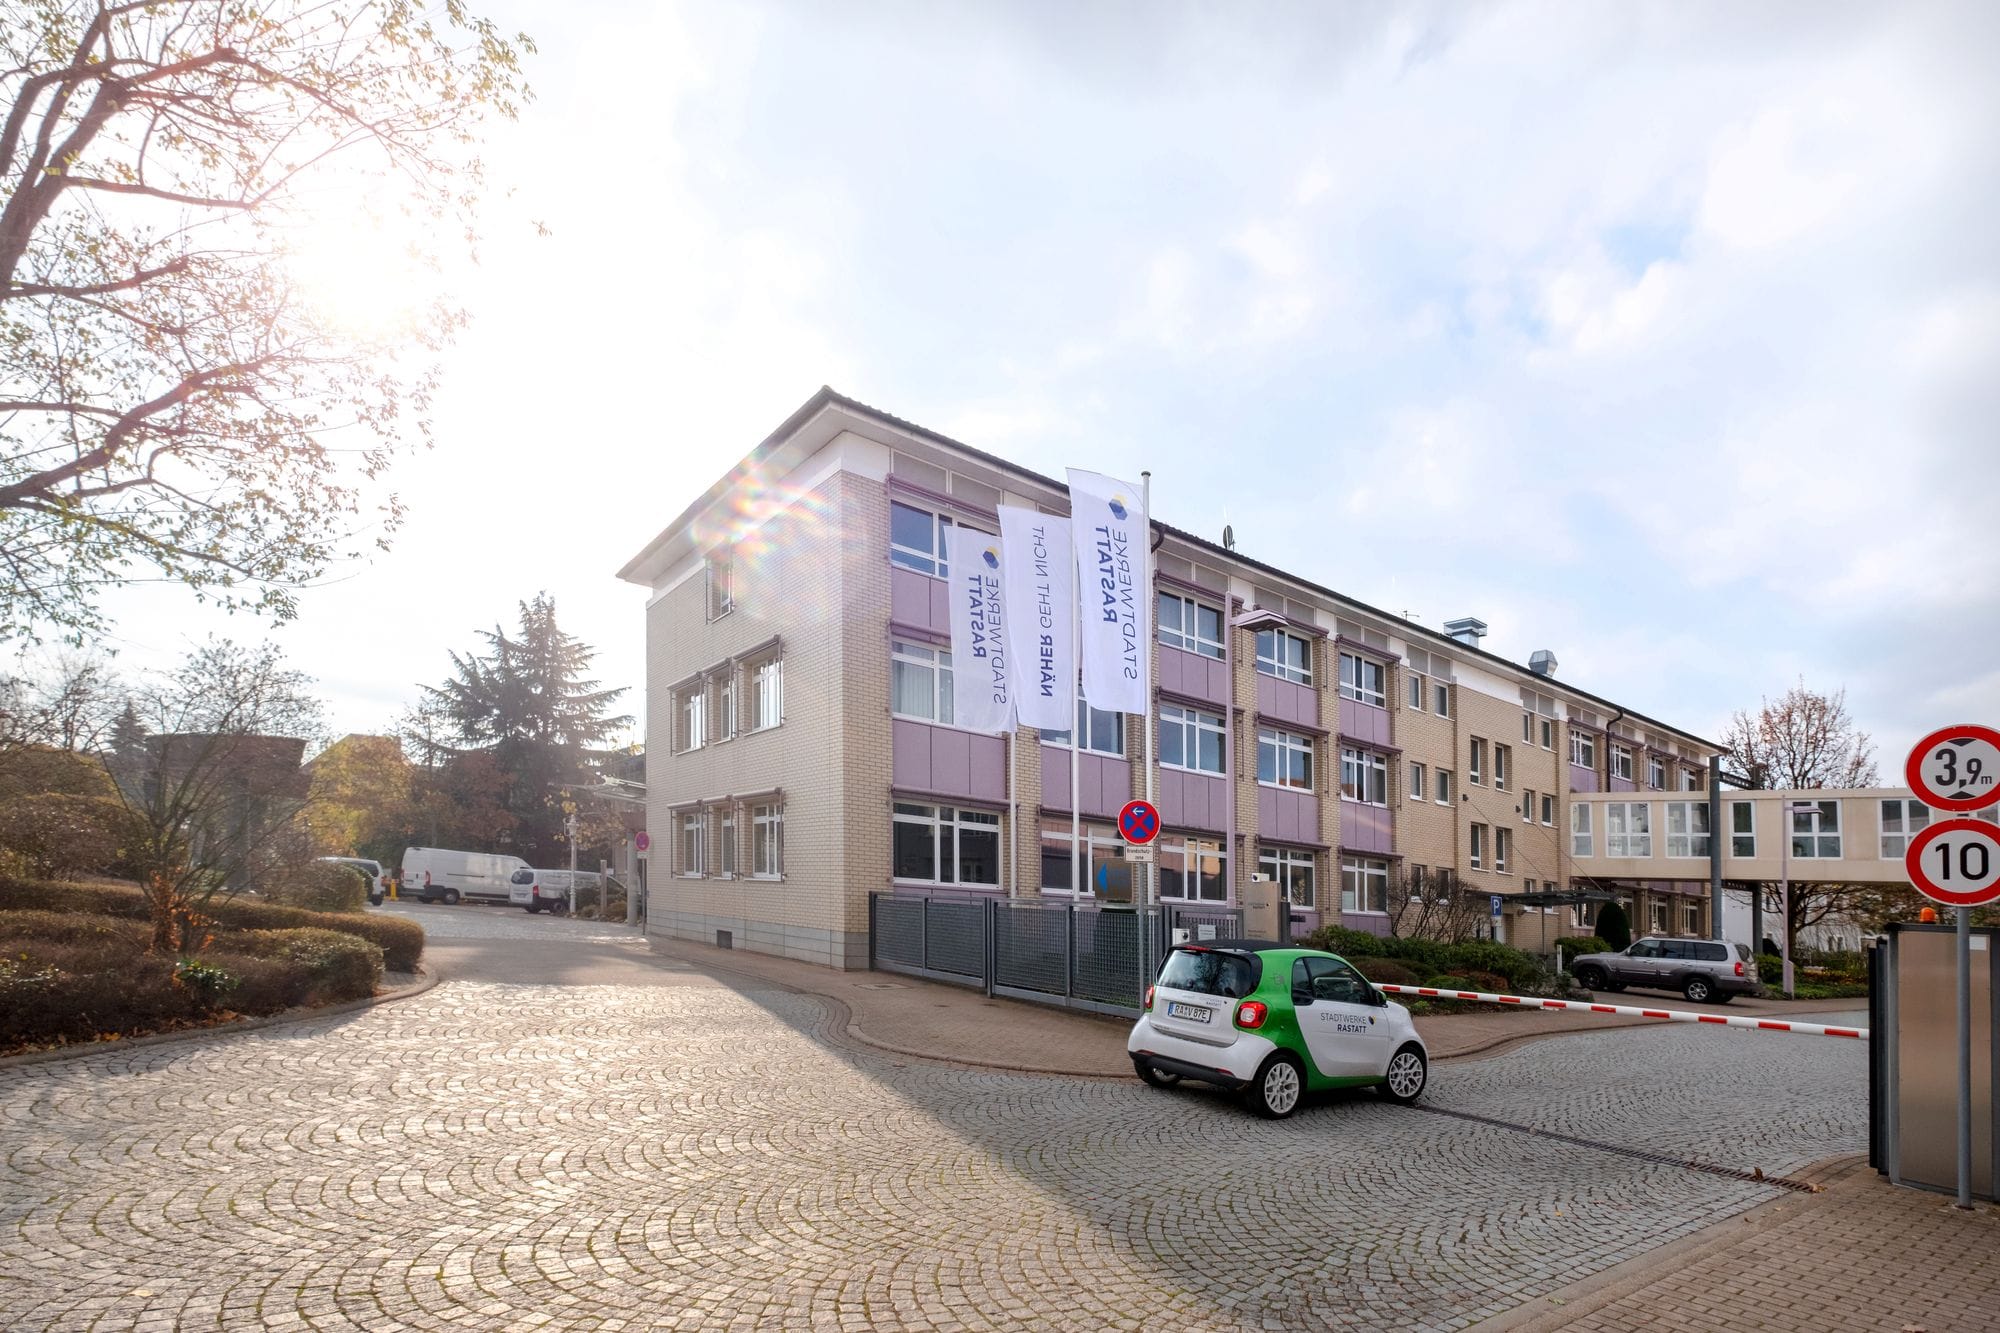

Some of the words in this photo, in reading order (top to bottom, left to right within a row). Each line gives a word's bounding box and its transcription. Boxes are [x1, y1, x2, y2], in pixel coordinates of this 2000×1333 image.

[1935, 842, 1989, 880] 10
[1493, 899, 1500, 914] P
[1320, 1012, 1366, 1024] STADTWERKE
[1337, 1024, 1367, 1033] RASTATT
